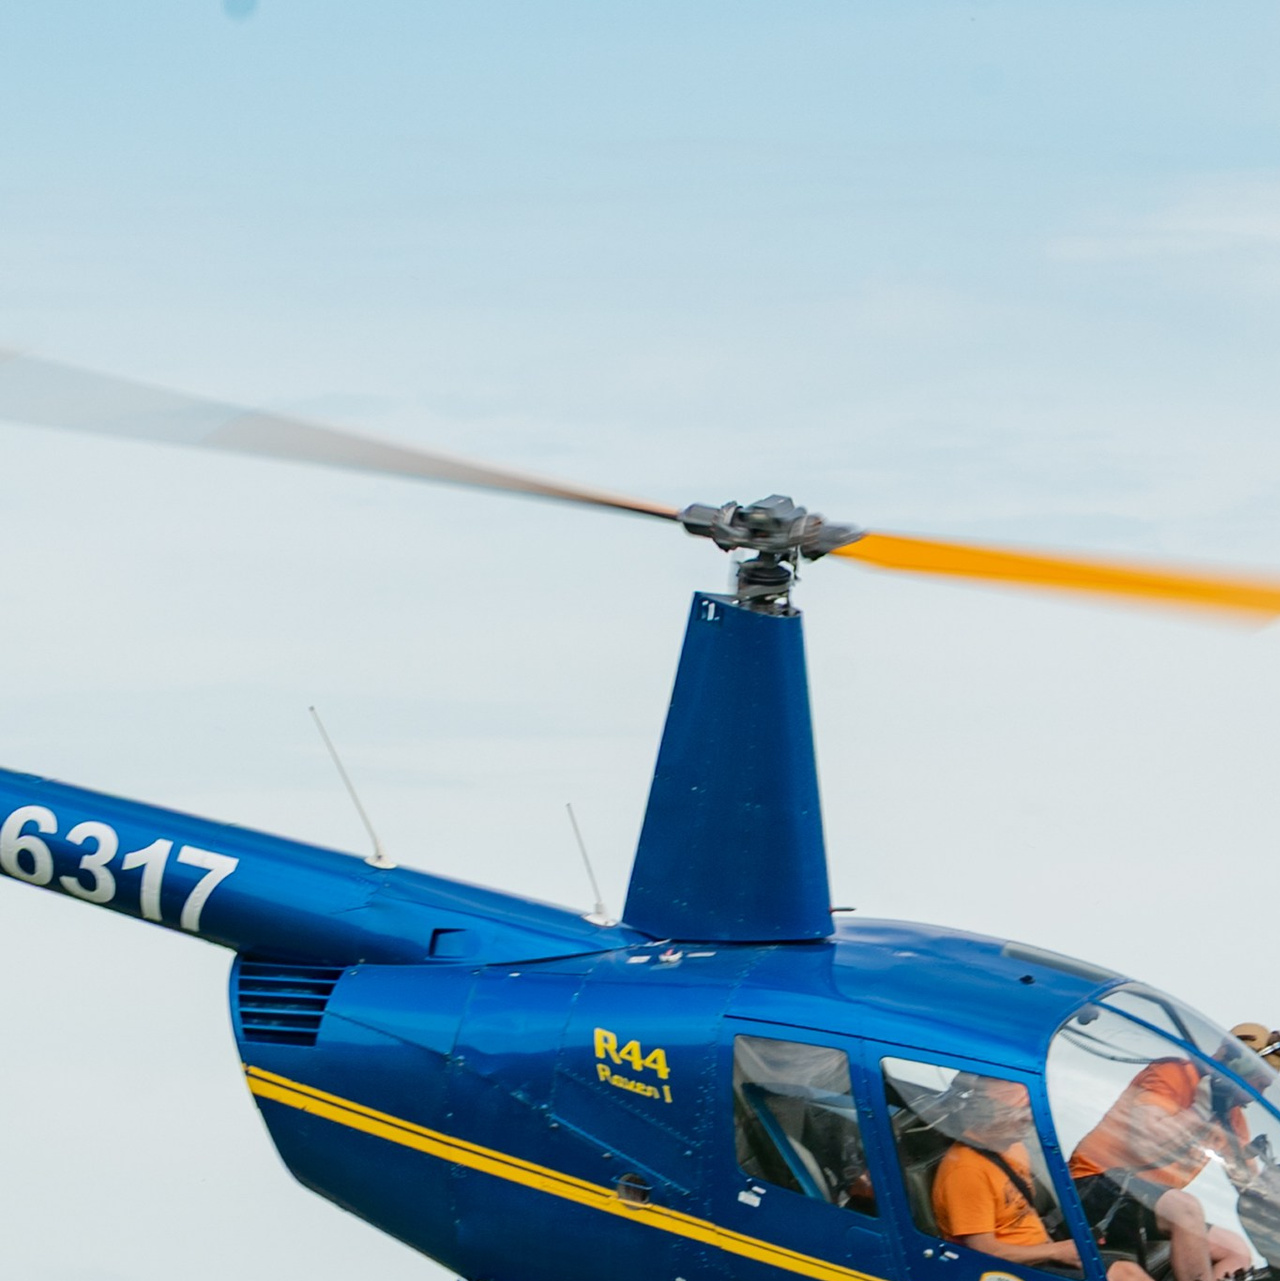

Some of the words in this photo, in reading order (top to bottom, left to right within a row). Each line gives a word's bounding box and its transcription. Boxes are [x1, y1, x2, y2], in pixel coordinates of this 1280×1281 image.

[0, 805, 239, 932] 6317
[594, 1027, 670, 1079] R44
[596, 1063, 660, 1099] Raven
